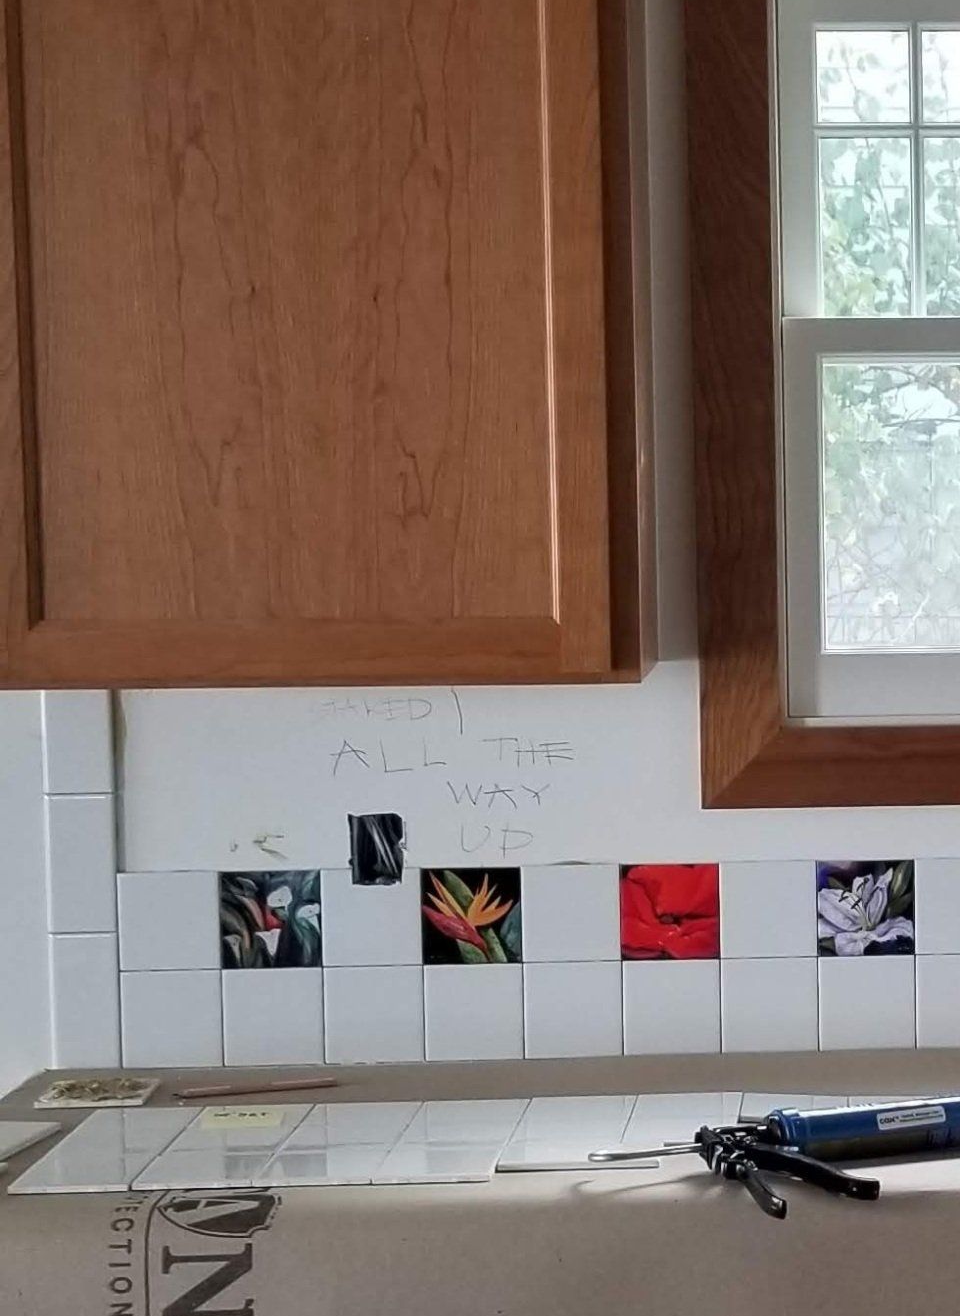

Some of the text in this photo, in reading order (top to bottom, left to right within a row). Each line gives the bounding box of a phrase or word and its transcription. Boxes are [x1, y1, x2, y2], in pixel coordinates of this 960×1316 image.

[329, 737, 574, 776] ALL THE
[446, 780, 550, 810] WAY
[460, 820, 534, 859] UP
